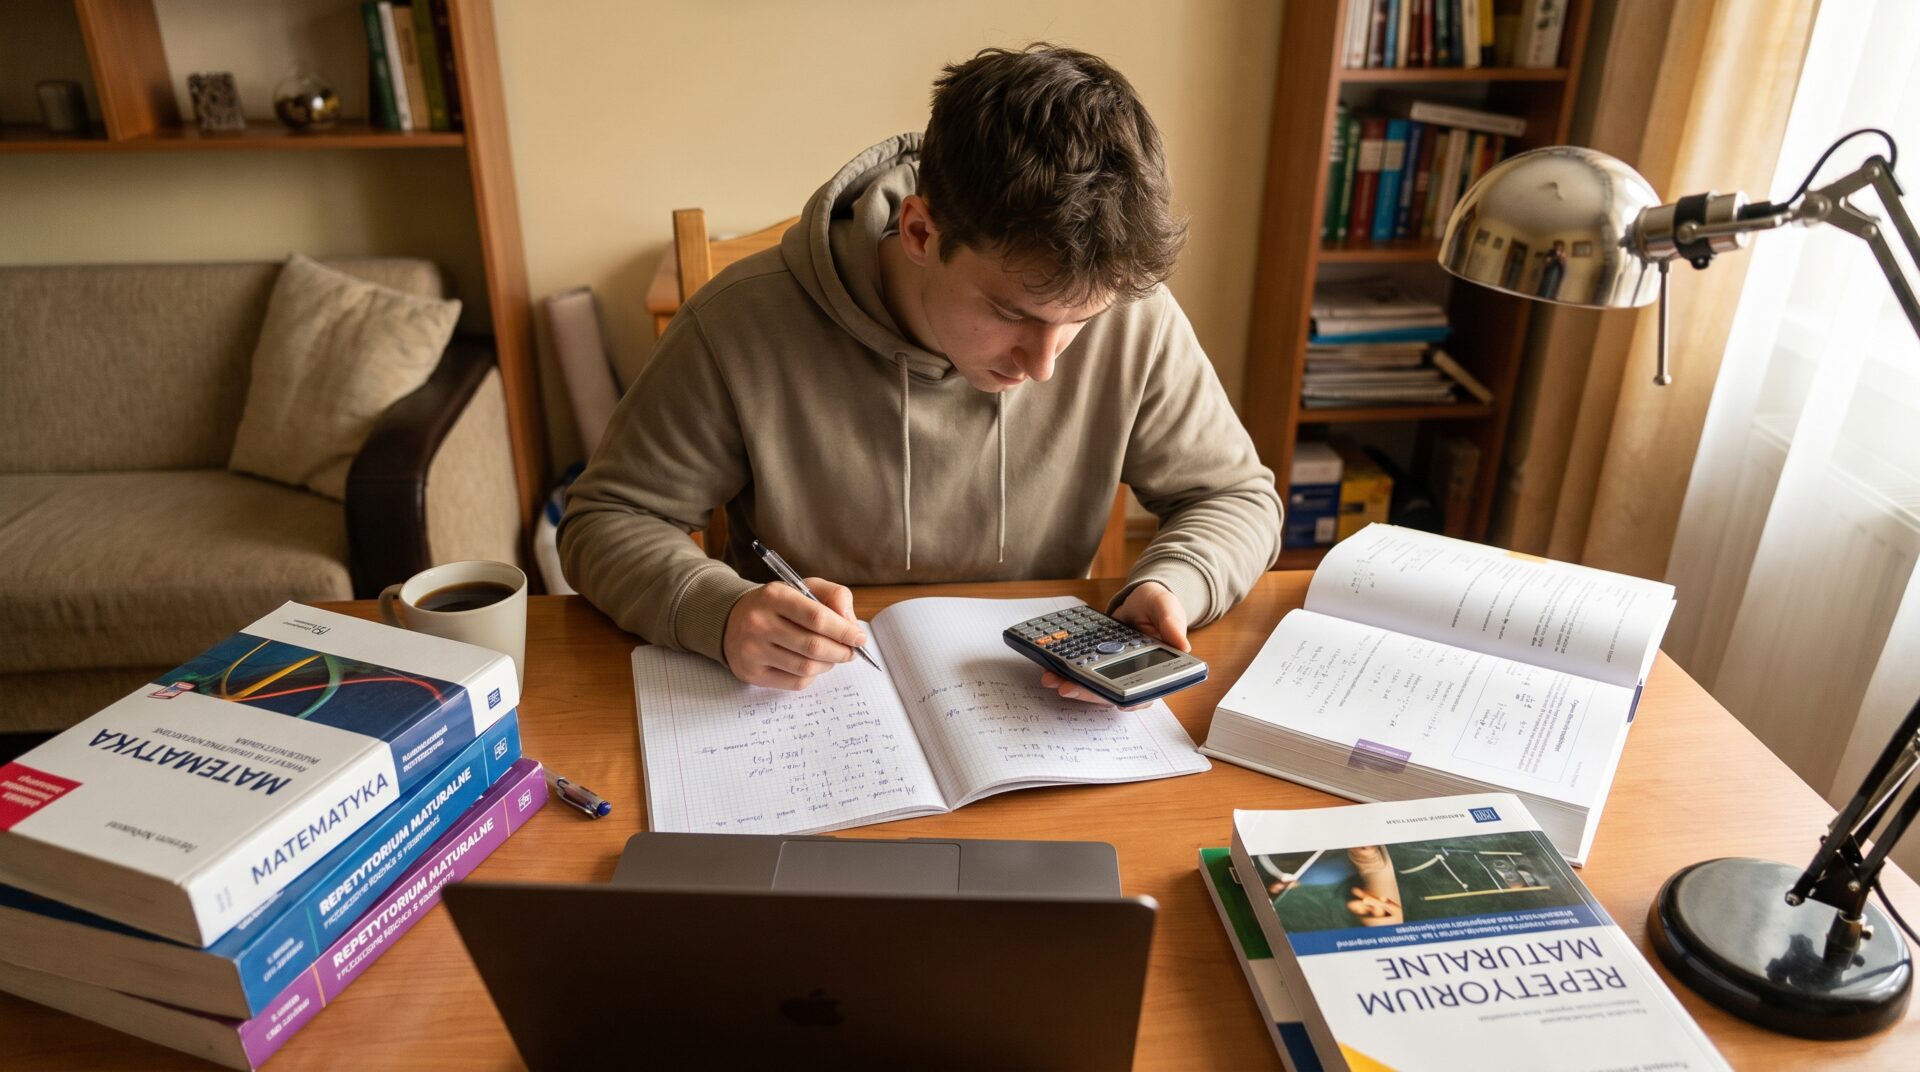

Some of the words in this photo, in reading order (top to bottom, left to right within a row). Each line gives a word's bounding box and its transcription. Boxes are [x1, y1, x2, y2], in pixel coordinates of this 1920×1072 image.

[88, 728, 293, 796] MATEMATYKA
[251, 772, 389, 885] MATEMATYKA
[319, 829, 410, 916] REPETYTORIUM
[410, 766, 472, 832] MATURALNE
[332, 877, 428, 968] REPETYTORIUM
[429, 817, 494, 884] MATURALNE
[1357, 966, 1628, 1016] REPETYORIUM
[1376, 937, 1603, 980] MATURALNE
